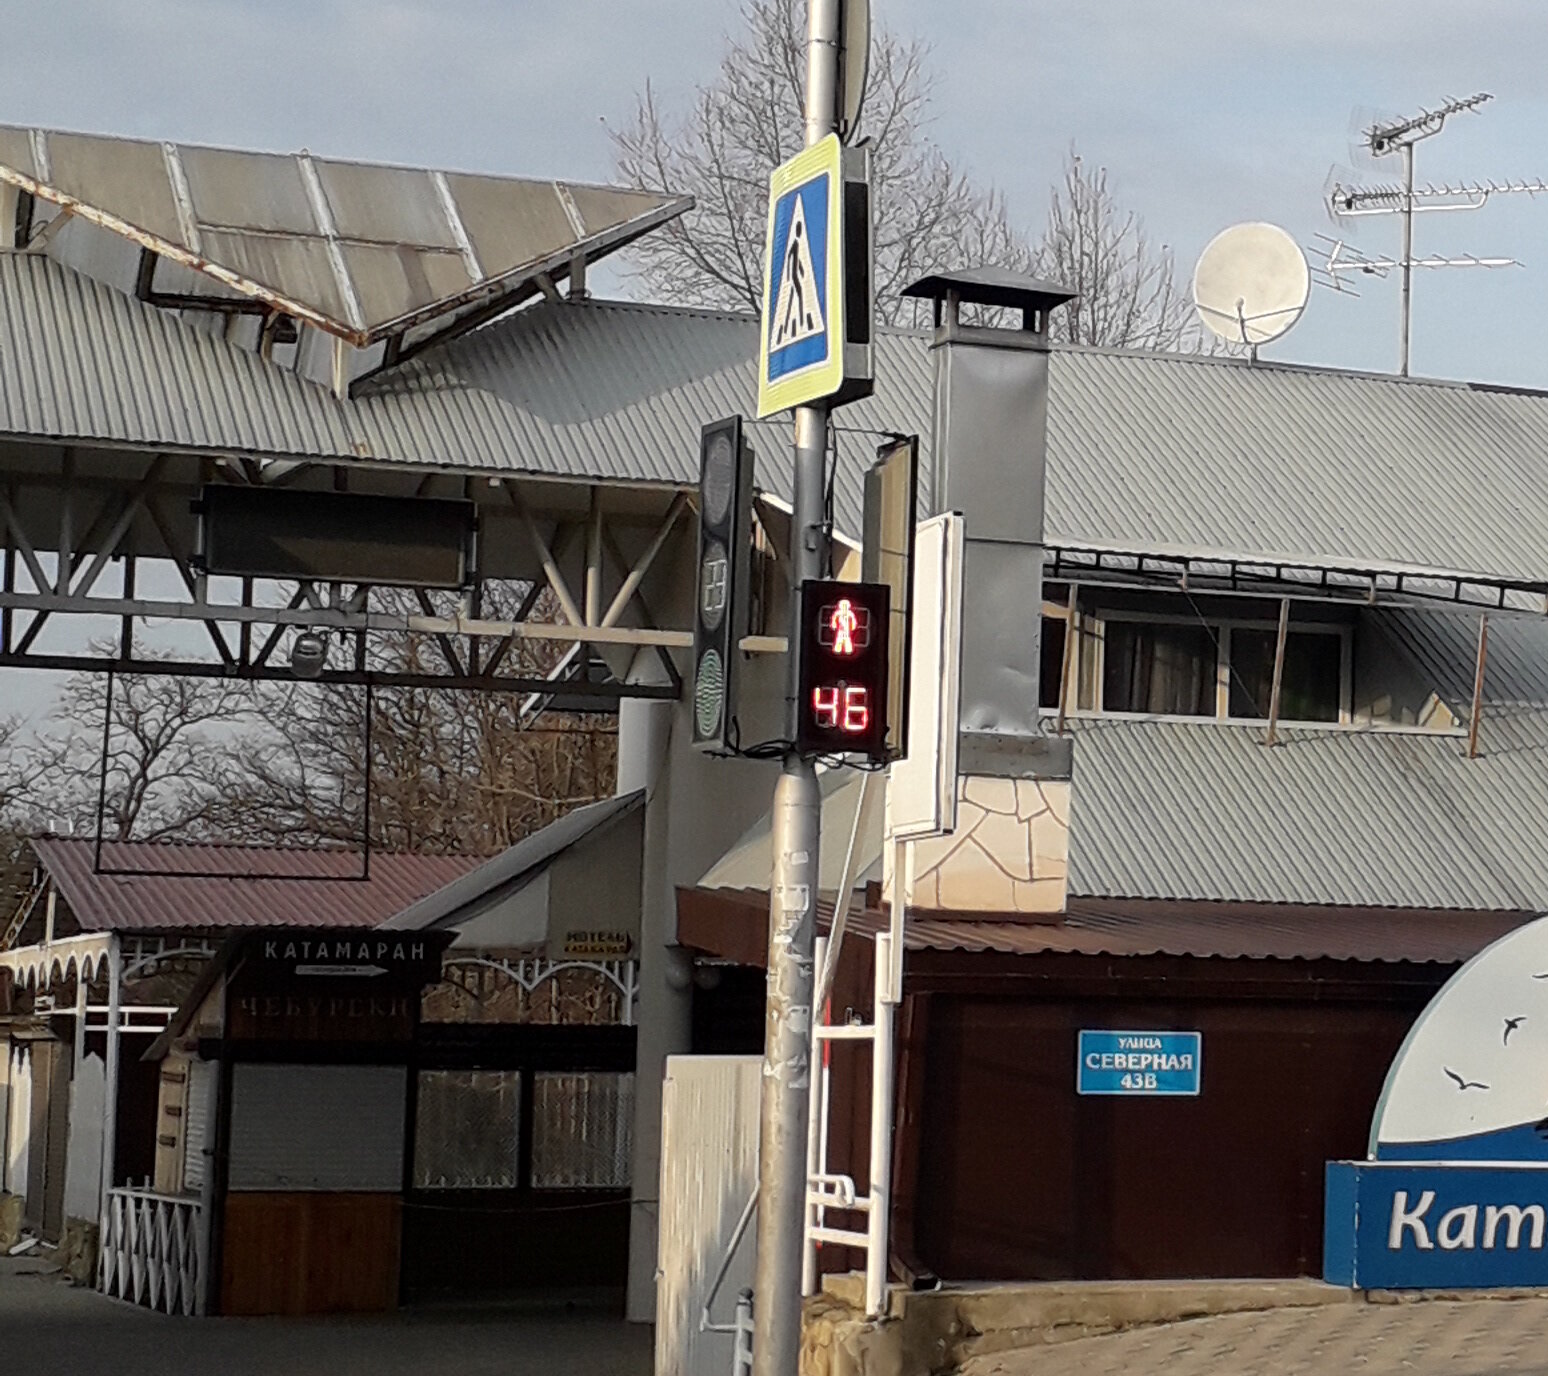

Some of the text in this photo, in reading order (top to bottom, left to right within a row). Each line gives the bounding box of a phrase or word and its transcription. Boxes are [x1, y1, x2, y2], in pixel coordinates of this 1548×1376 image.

[813, 687, 869, 731] 46
[265, 941, 425, 960] КАТАМАРАН
[241, 997, 408, 1018] ЧЕБУРЕКИ
[1118, 1037, 1162, 1049] УЛИЦА
[1085, 1053, 1193, 1070] СЕВЕРНАЯ
